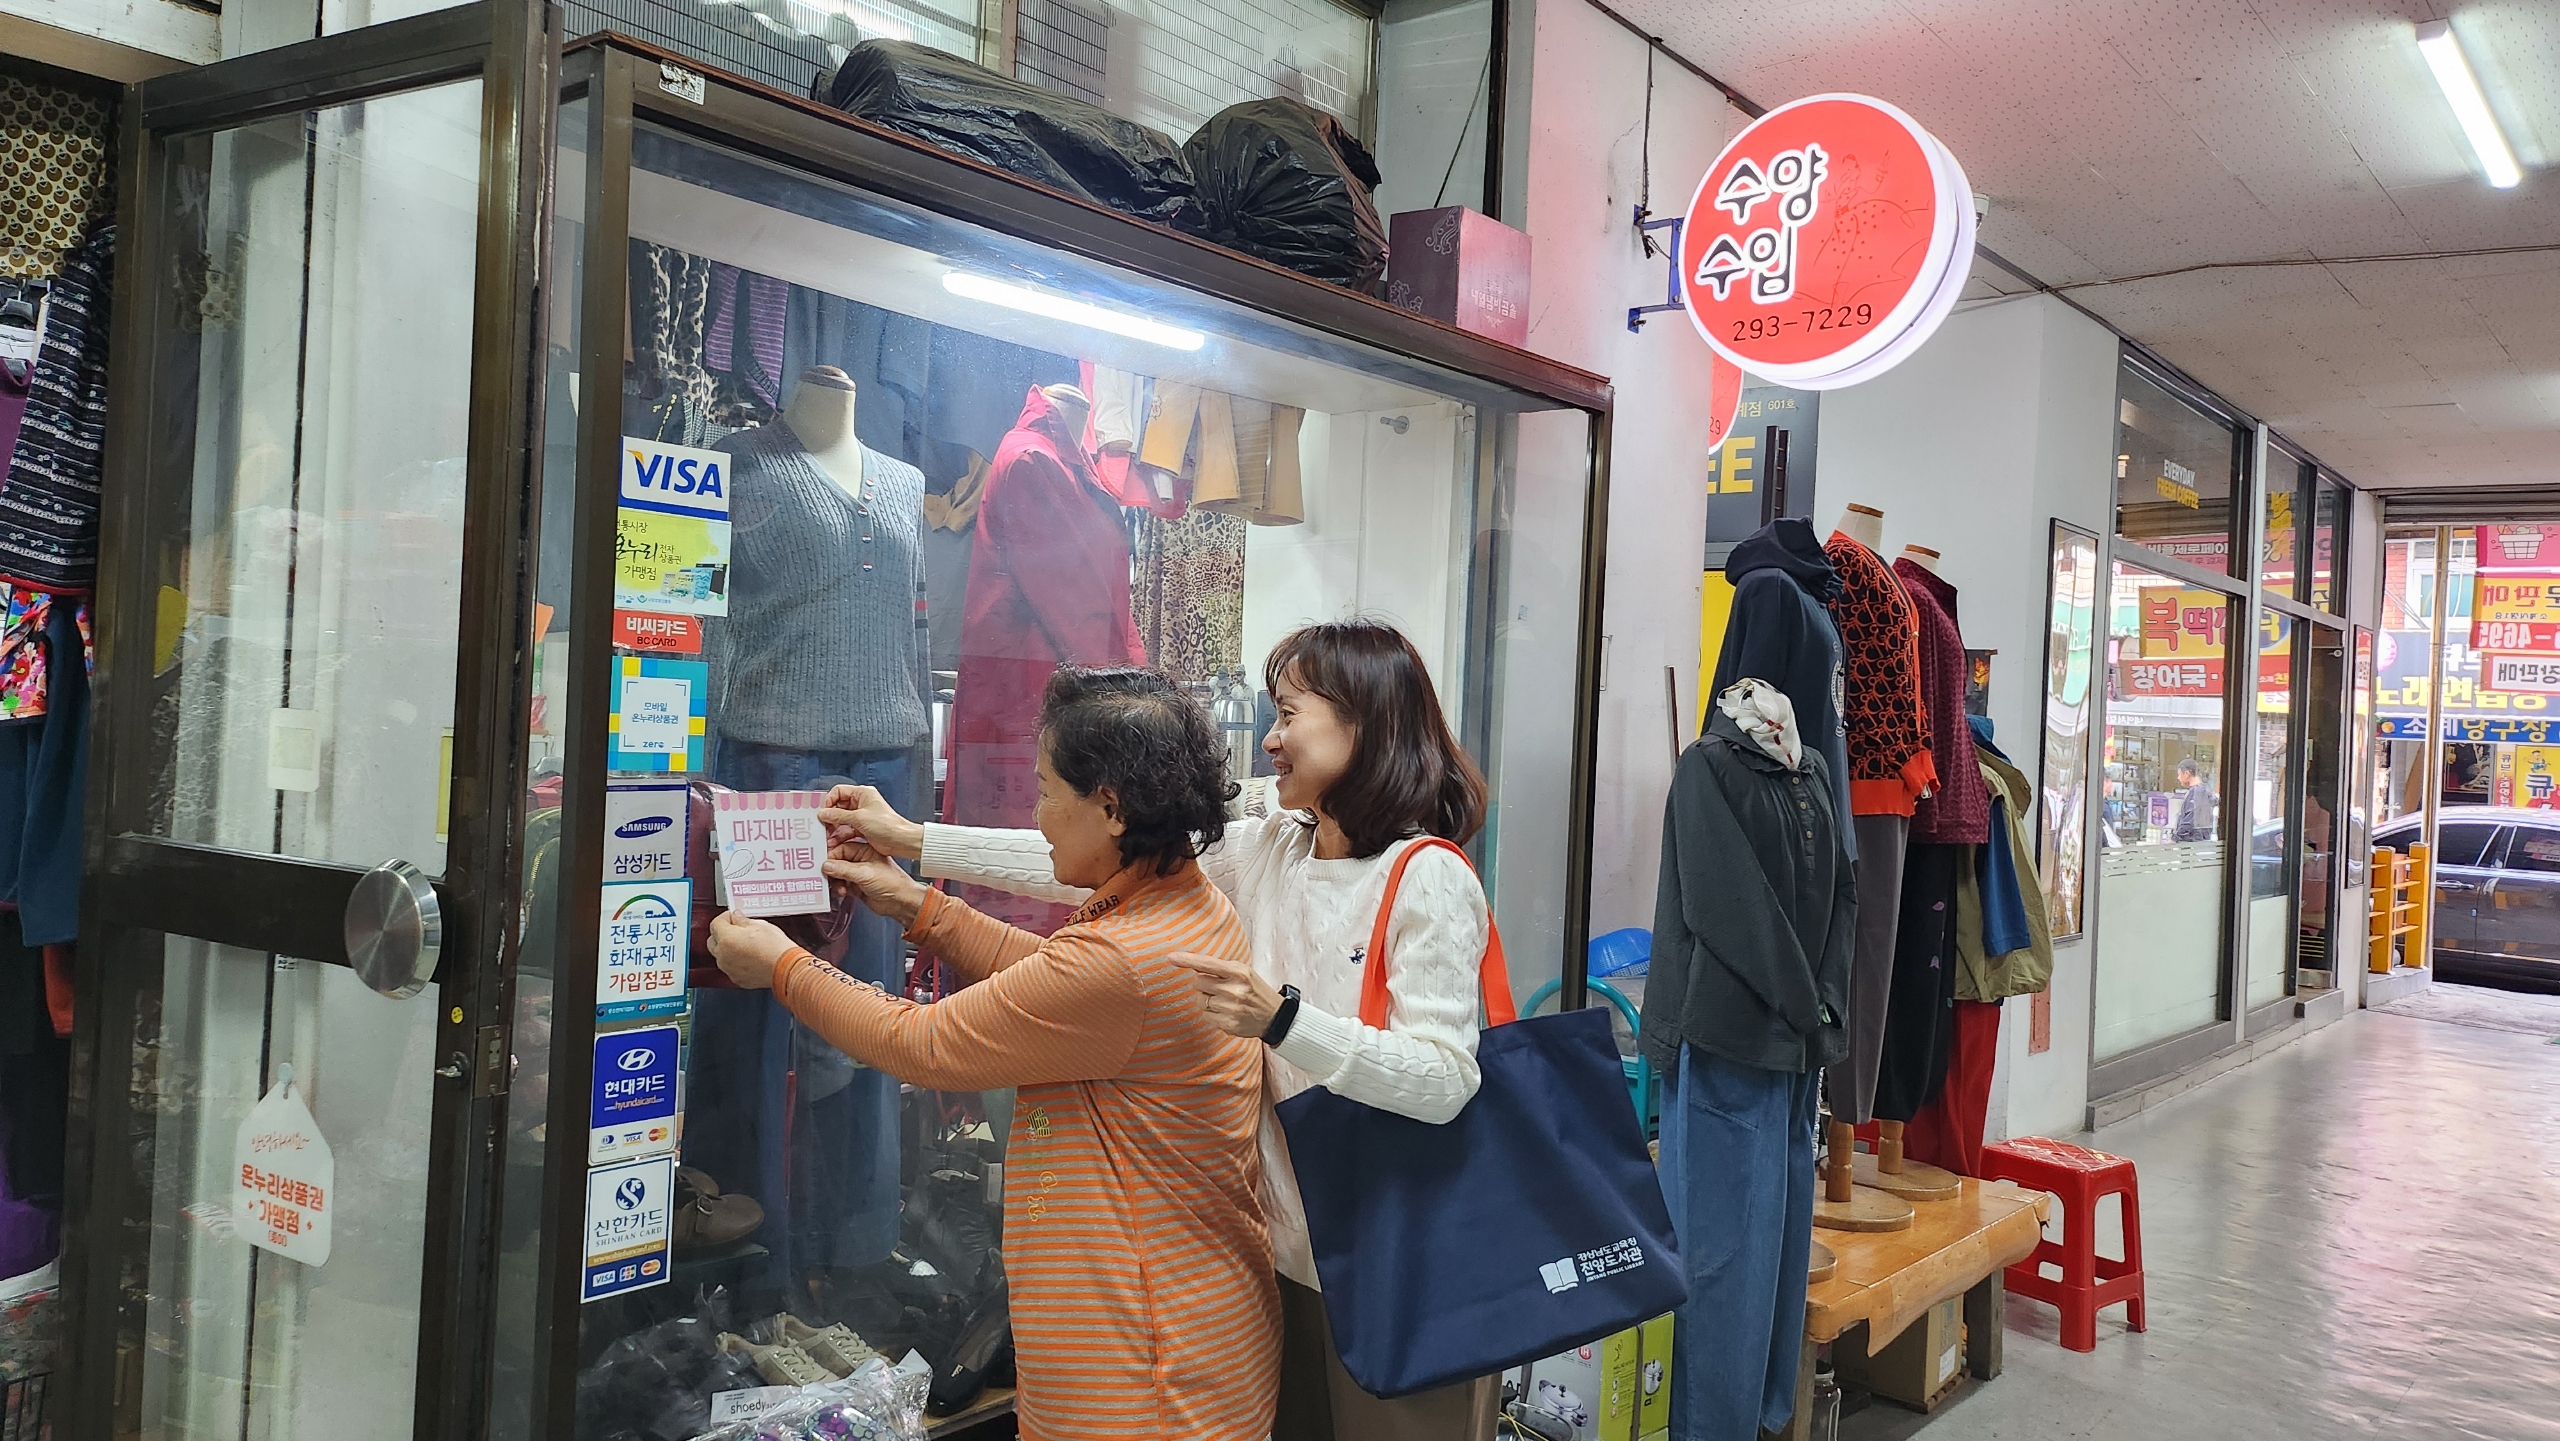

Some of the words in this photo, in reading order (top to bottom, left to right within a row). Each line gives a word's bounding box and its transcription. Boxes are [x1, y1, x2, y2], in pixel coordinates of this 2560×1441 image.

[1716, 144, 1826, 224] 수양
[1697, 227, 1795, 302] 수임
[1733, 303, 1873, 342] 293-7229
[1767, 398, 1796, 411] 601호
[627, 450, 723, 498] VISA
[2163, 459, 2196, 488] EVERYDAY
[659, 554, 682, 565] 상품권
[660, 545, 675, 554] 전자
[624, 565, 657, 581] 가맹점
[626, 616, 688, 636] 비씨카드
[637, 636, 650, 645] BC
[652, 637, 677, 647] CARD
[643, 702, 668, 712] 모바일
[631, 713, 679, 725] 온누리상품권
[642, 741, 665, 749] zero
[621, 822, 667, 833] SAMSUNG
[733, 818, 813, 842] 마지바랑
[613, 853, 672, 875] 삼성카드
[1087, 894, 1121, 917] WEAR
[610, 922, 677, 945] 전통시장
[609, 945, 675, 967] 화재공제
[609, 970, 675, 993] 가입점포
[604, 1074, 666, 1099] 현대카드
[625, 1133, 641, 1143] VISA
[241, 1163, 324, 1212] 온누리상품권
[258, 1199, 300, 1235] 가맹점
[594, 1208, 663, 1238] 신한카드
[595, 1233, 637, 1247] SHINHAN
[639, 1226, 663, 1239] CARD
[1577, 1236, 1638, 1261] 경상남도교육청
[1580, 1246, 1645, 1276] 진양도서관
[595, 1273, 615, 1284] VISA
